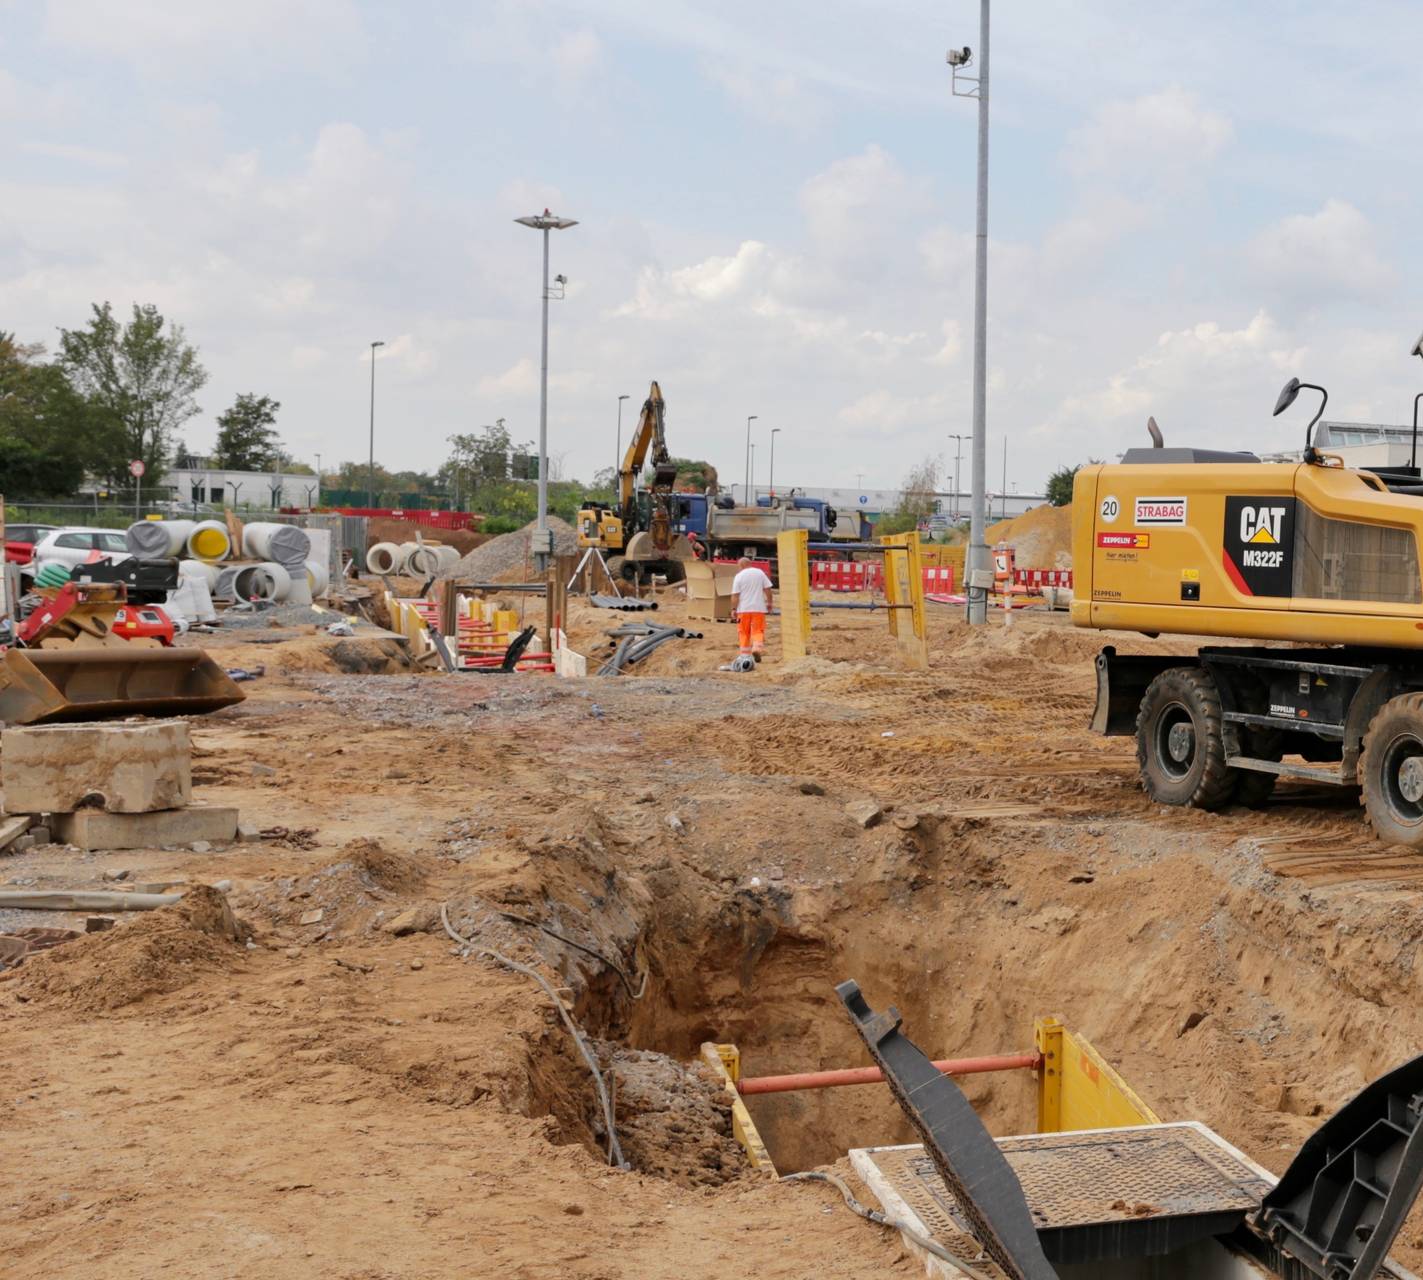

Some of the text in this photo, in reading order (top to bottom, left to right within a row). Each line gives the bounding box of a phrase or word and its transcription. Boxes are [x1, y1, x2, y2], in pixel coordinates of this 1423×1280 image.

[1102, 501, 1117, 516] 20
[1137, 506, 1184, 517] STRABAG
[1240, 506, 1286, 544] CAT
[1103, 536, 1131, 544] ZEPPELIN
[1243, 550, 1284, 568] M322F
